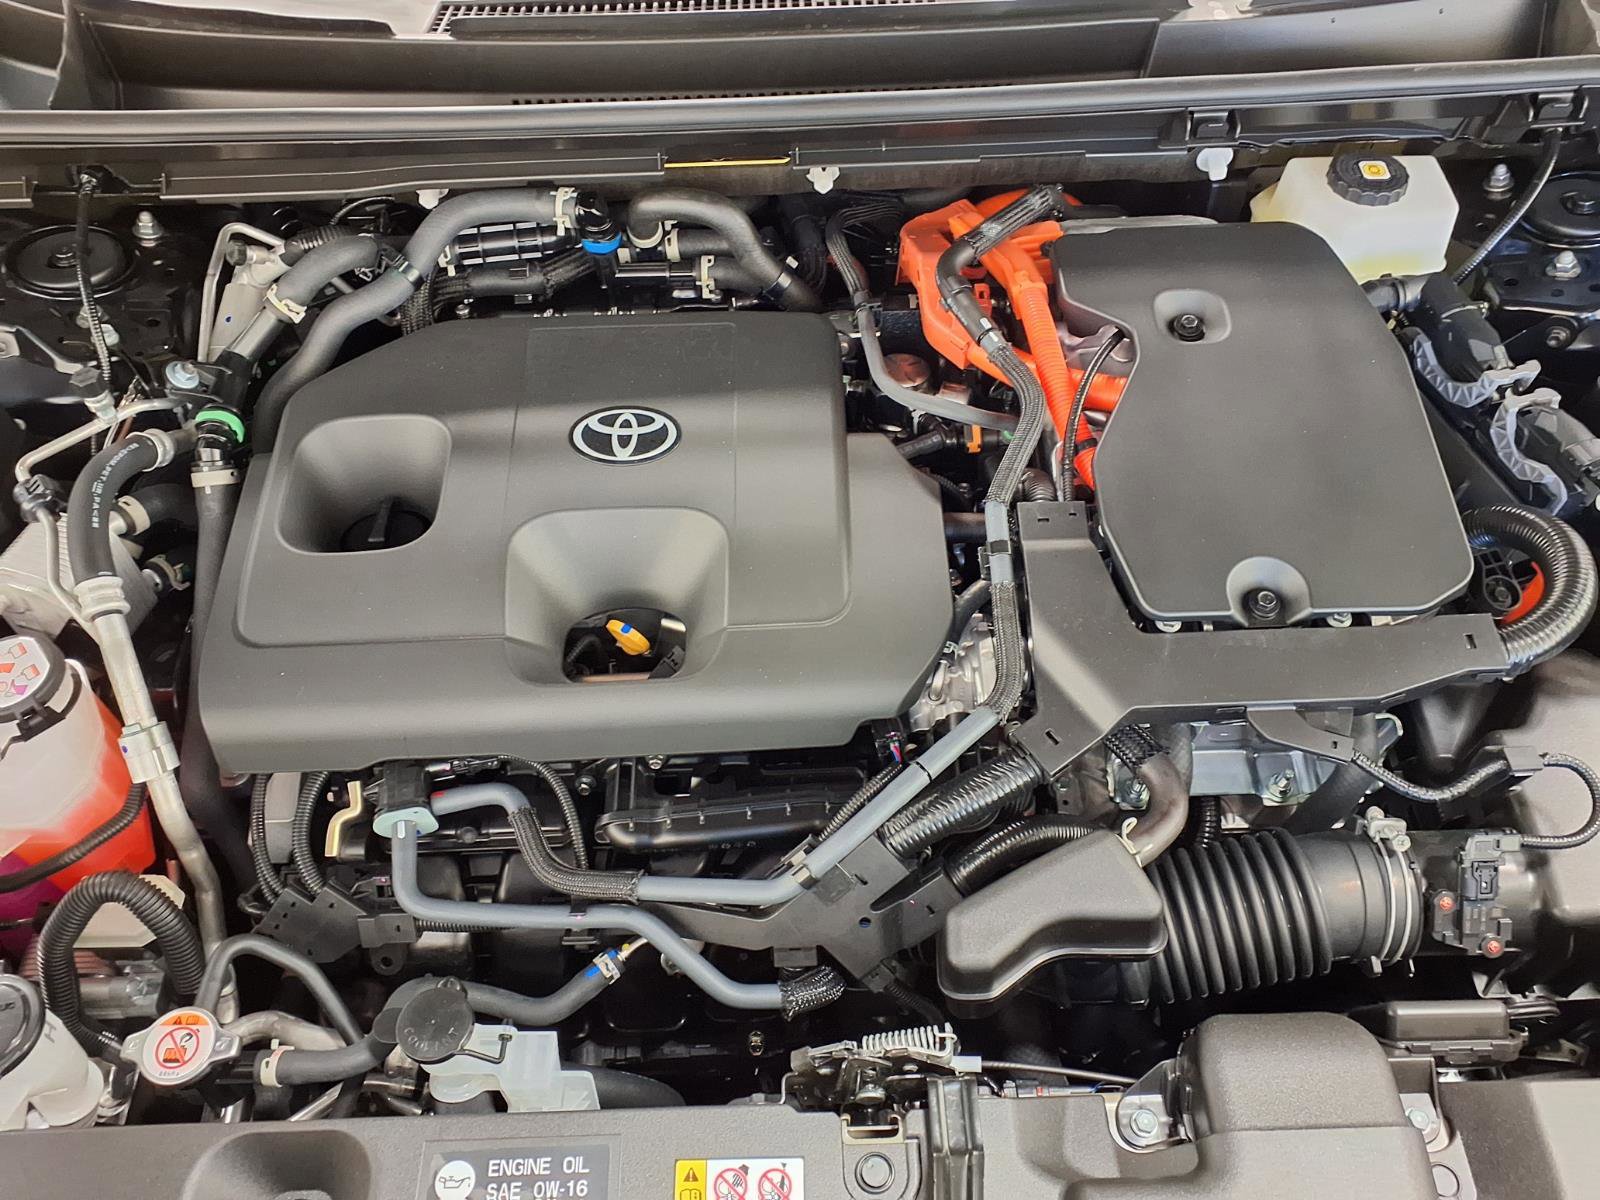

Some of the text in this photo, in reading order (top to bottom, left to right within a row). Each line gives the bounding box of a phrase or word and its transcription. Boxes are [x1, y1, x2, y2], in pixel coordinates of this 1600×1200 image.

[487, 1155, 590, 1177] ENGINE OIL
[486, 1182, 522, 1200] SAE
